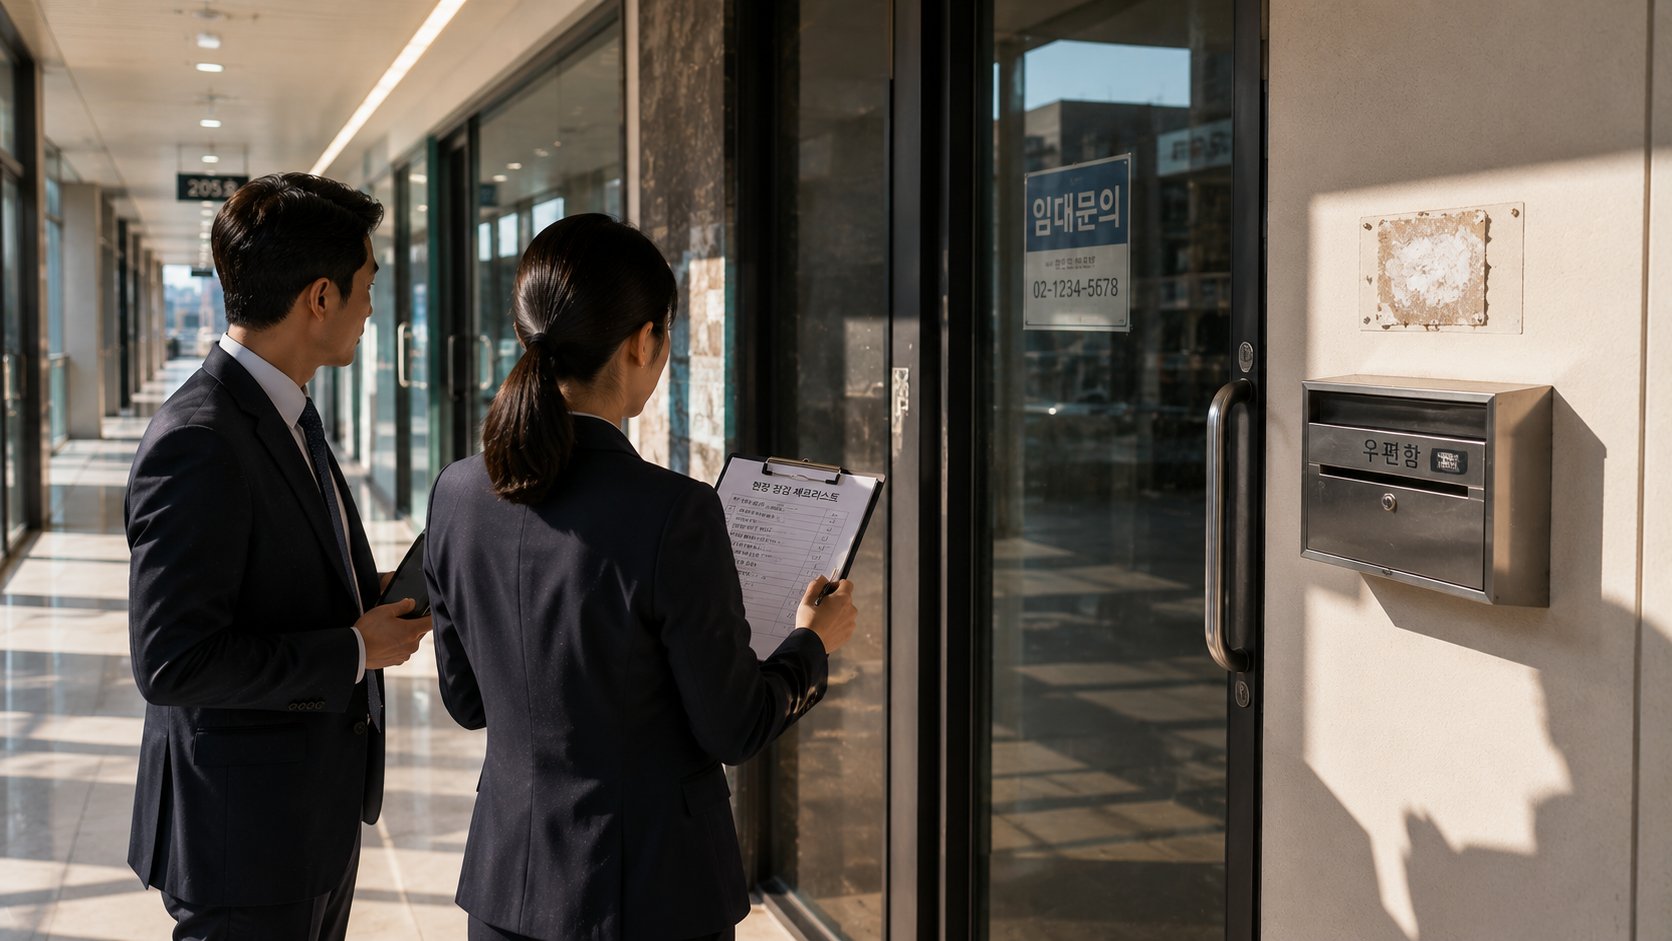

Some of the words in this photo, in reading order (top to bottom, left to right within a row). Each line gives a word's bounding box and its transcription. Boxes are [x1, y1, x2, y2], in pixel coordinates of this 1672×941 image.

[1033, 185, 1120, 236] 임대문의
[1033, 278, 1118, 298] 02-1234-5678
[1363, 439, 1421, 469] 우편함
